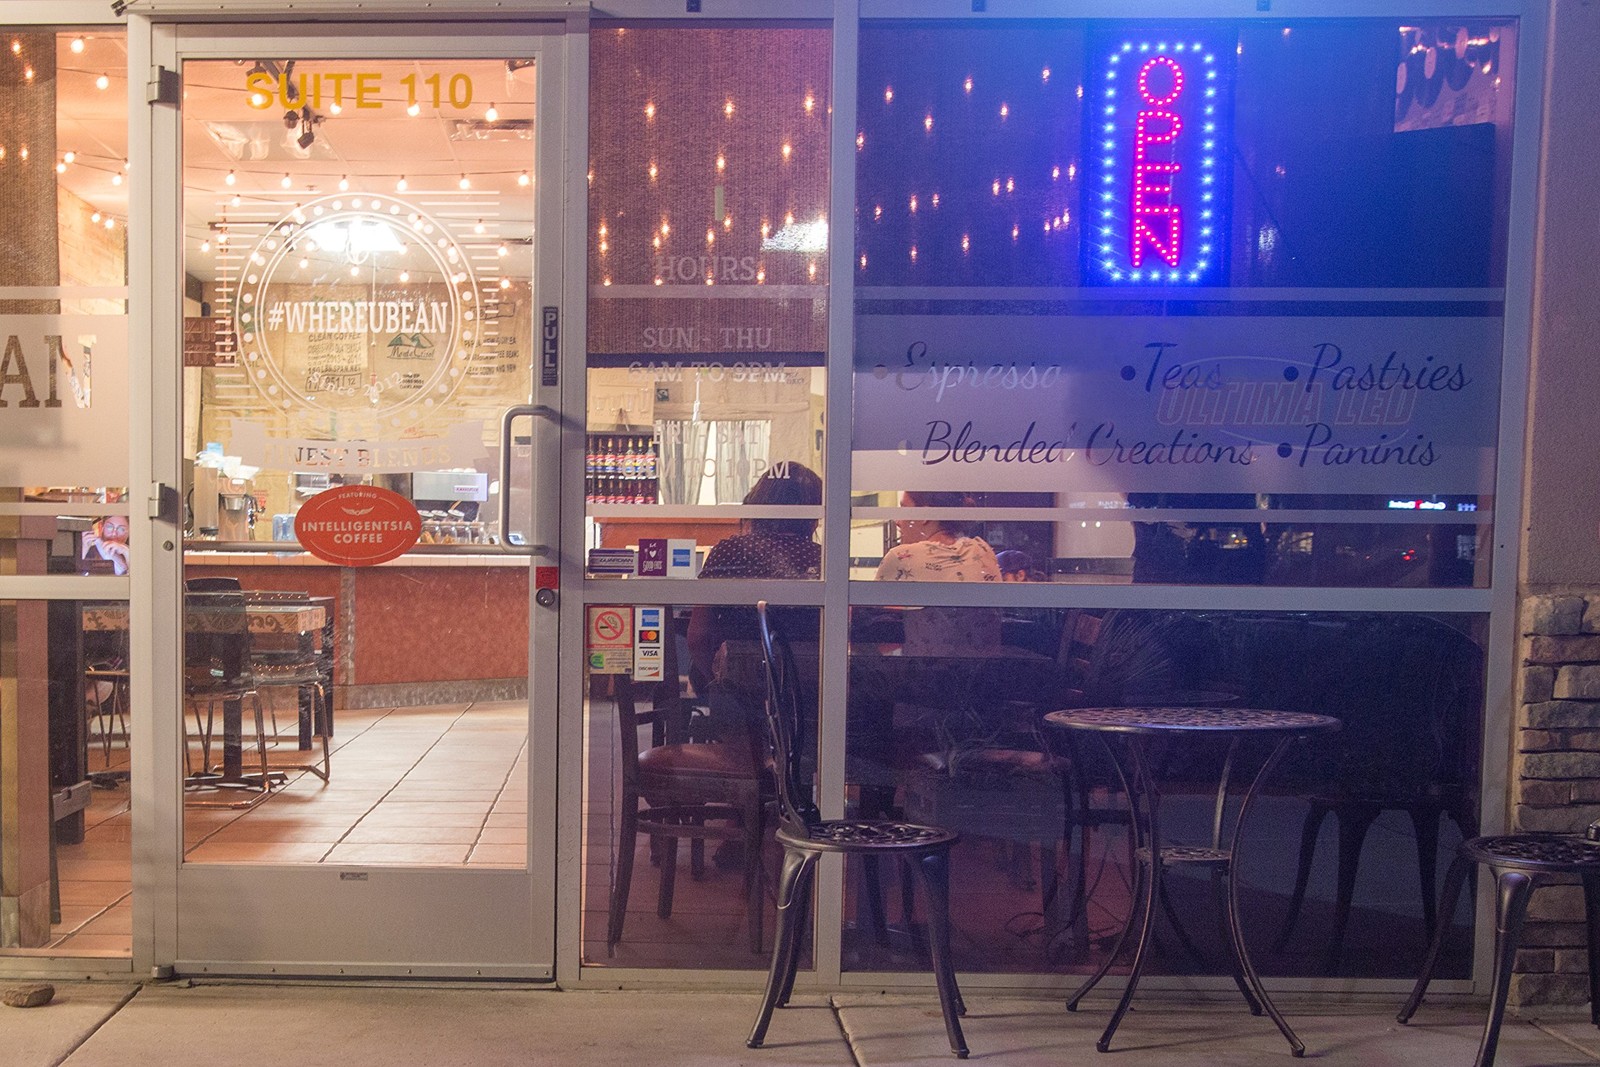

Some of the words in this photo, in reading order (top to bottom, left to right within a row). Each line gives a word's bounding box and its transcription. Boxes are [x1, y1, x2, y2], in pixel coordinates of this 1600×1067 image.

[245, 72, 383, 110] SUITE
[400, 72, 474, 110] 110
[1131, 56, 1184, 267] OPEN
[656, 256, 756, 282] HOURS
[267, 301, 448, 334] #WHEREUBEAN
[544, 312, 557, 368] PULL
[643, 327, 694, 349] SUN
[719, 327, 772, 349] THU
[0, 334, 97, 409] AN
[628, 361, 683, 383] 6AM
[691, 361, 725, 383] TO
[732, 361, 787, 383] 9PM
[896, 341, 1062, 403] Espresso
[1144, 343, 1226, 393] Teas
[1305, 343, 1472, 393] Pastries
[1156, 381, 1325, 426] ULTIMA
[1334, 381, 1419, 426] LED
[652, 422, 698, 446] FRI
[716, 421, 760, 446] SAT
[922, 420, 1077, 466] Blended
[1086, 420, 1257, 466] Creations
[1299, 421, 1443, 467] Paninis
[357, 445, 452, 468] BLENDS
[686, 458, 717, 479] TO
[726, 458, 791, 480] 10PM
[337, 491, 378, 500] FEATURING
[302, 520, 413, 533] INTELLIGENTSIA
[333, 533, 383, 545] COFFEE
